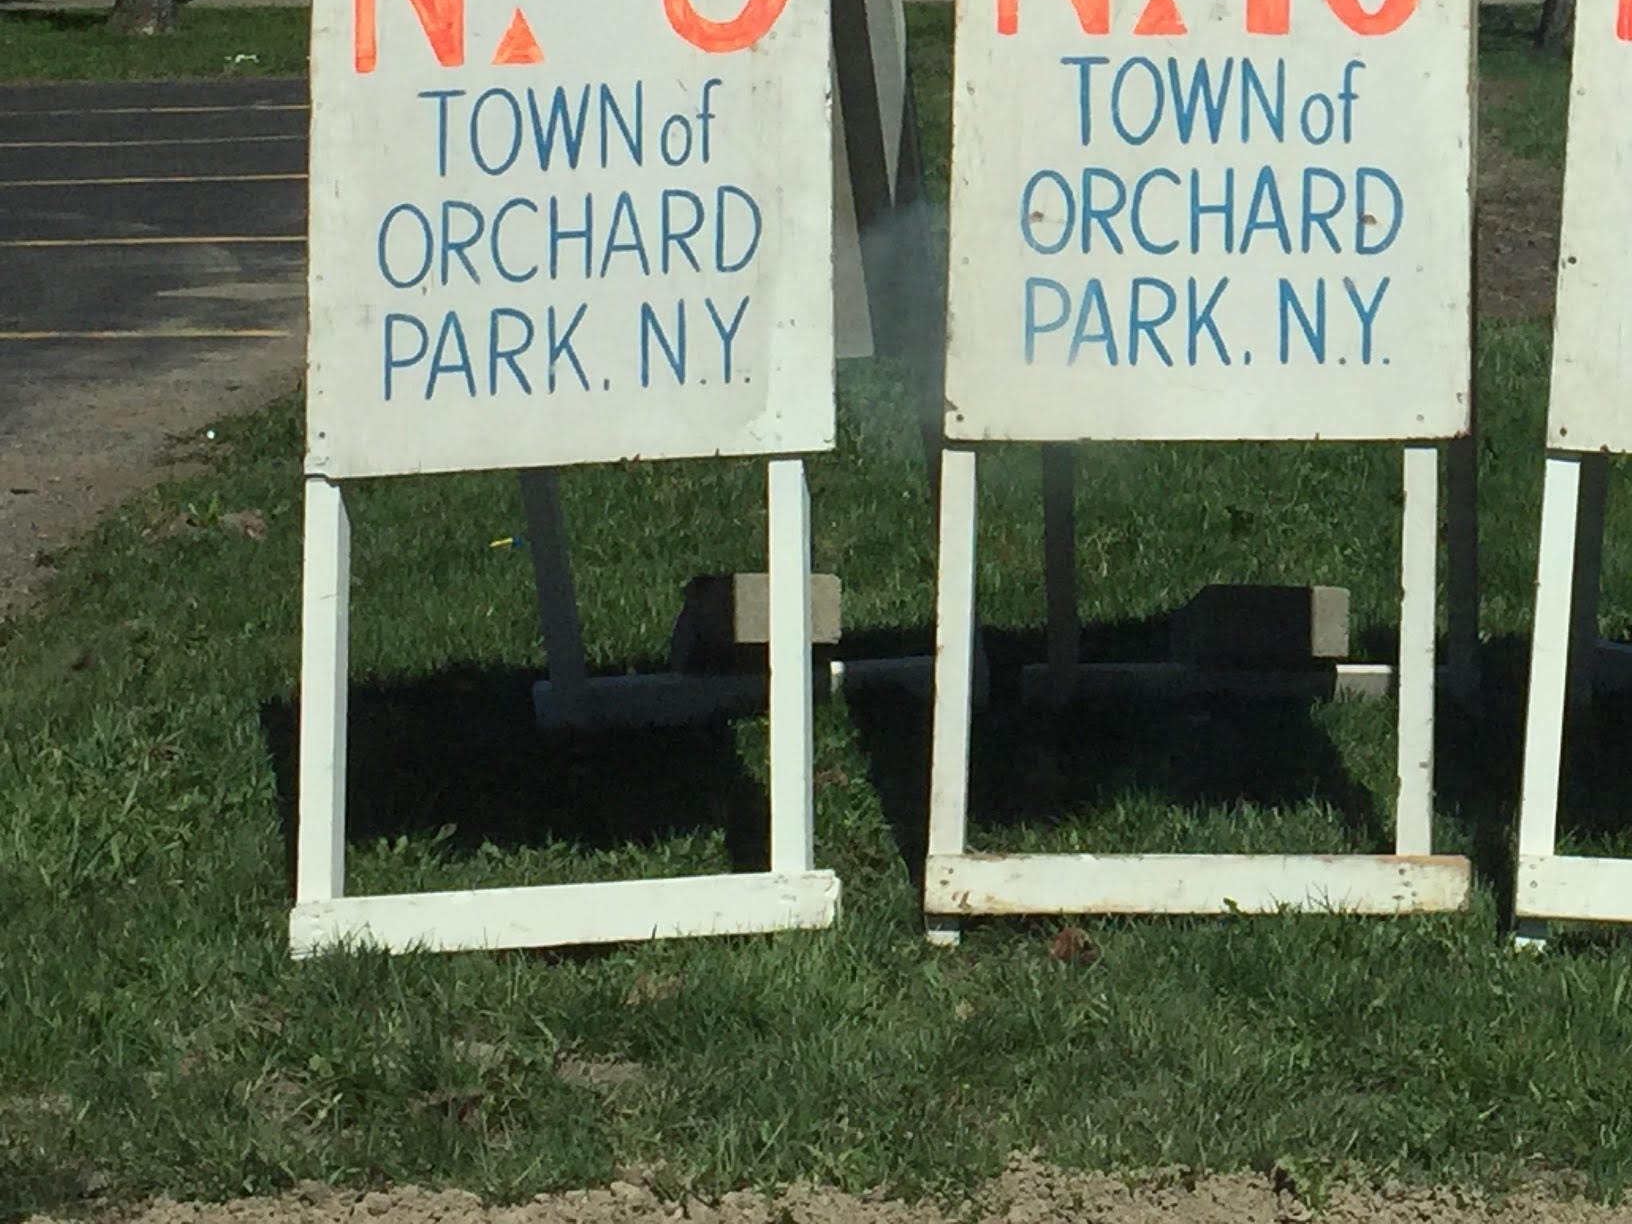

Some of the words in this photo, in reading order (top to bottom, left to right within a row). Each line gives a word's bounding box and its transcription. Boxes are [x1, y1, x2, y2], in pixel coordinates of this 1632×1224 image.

[421, 81, 643, 175] TOWN
[658, 78, 717, 167] of
[1061, 55, 1285, 146] TOWN
[1298, 60, 1363, 146] of
[376, 186, 760, 289] ORCHARD
[1020, 165, 1405, 256] ORCHARD
